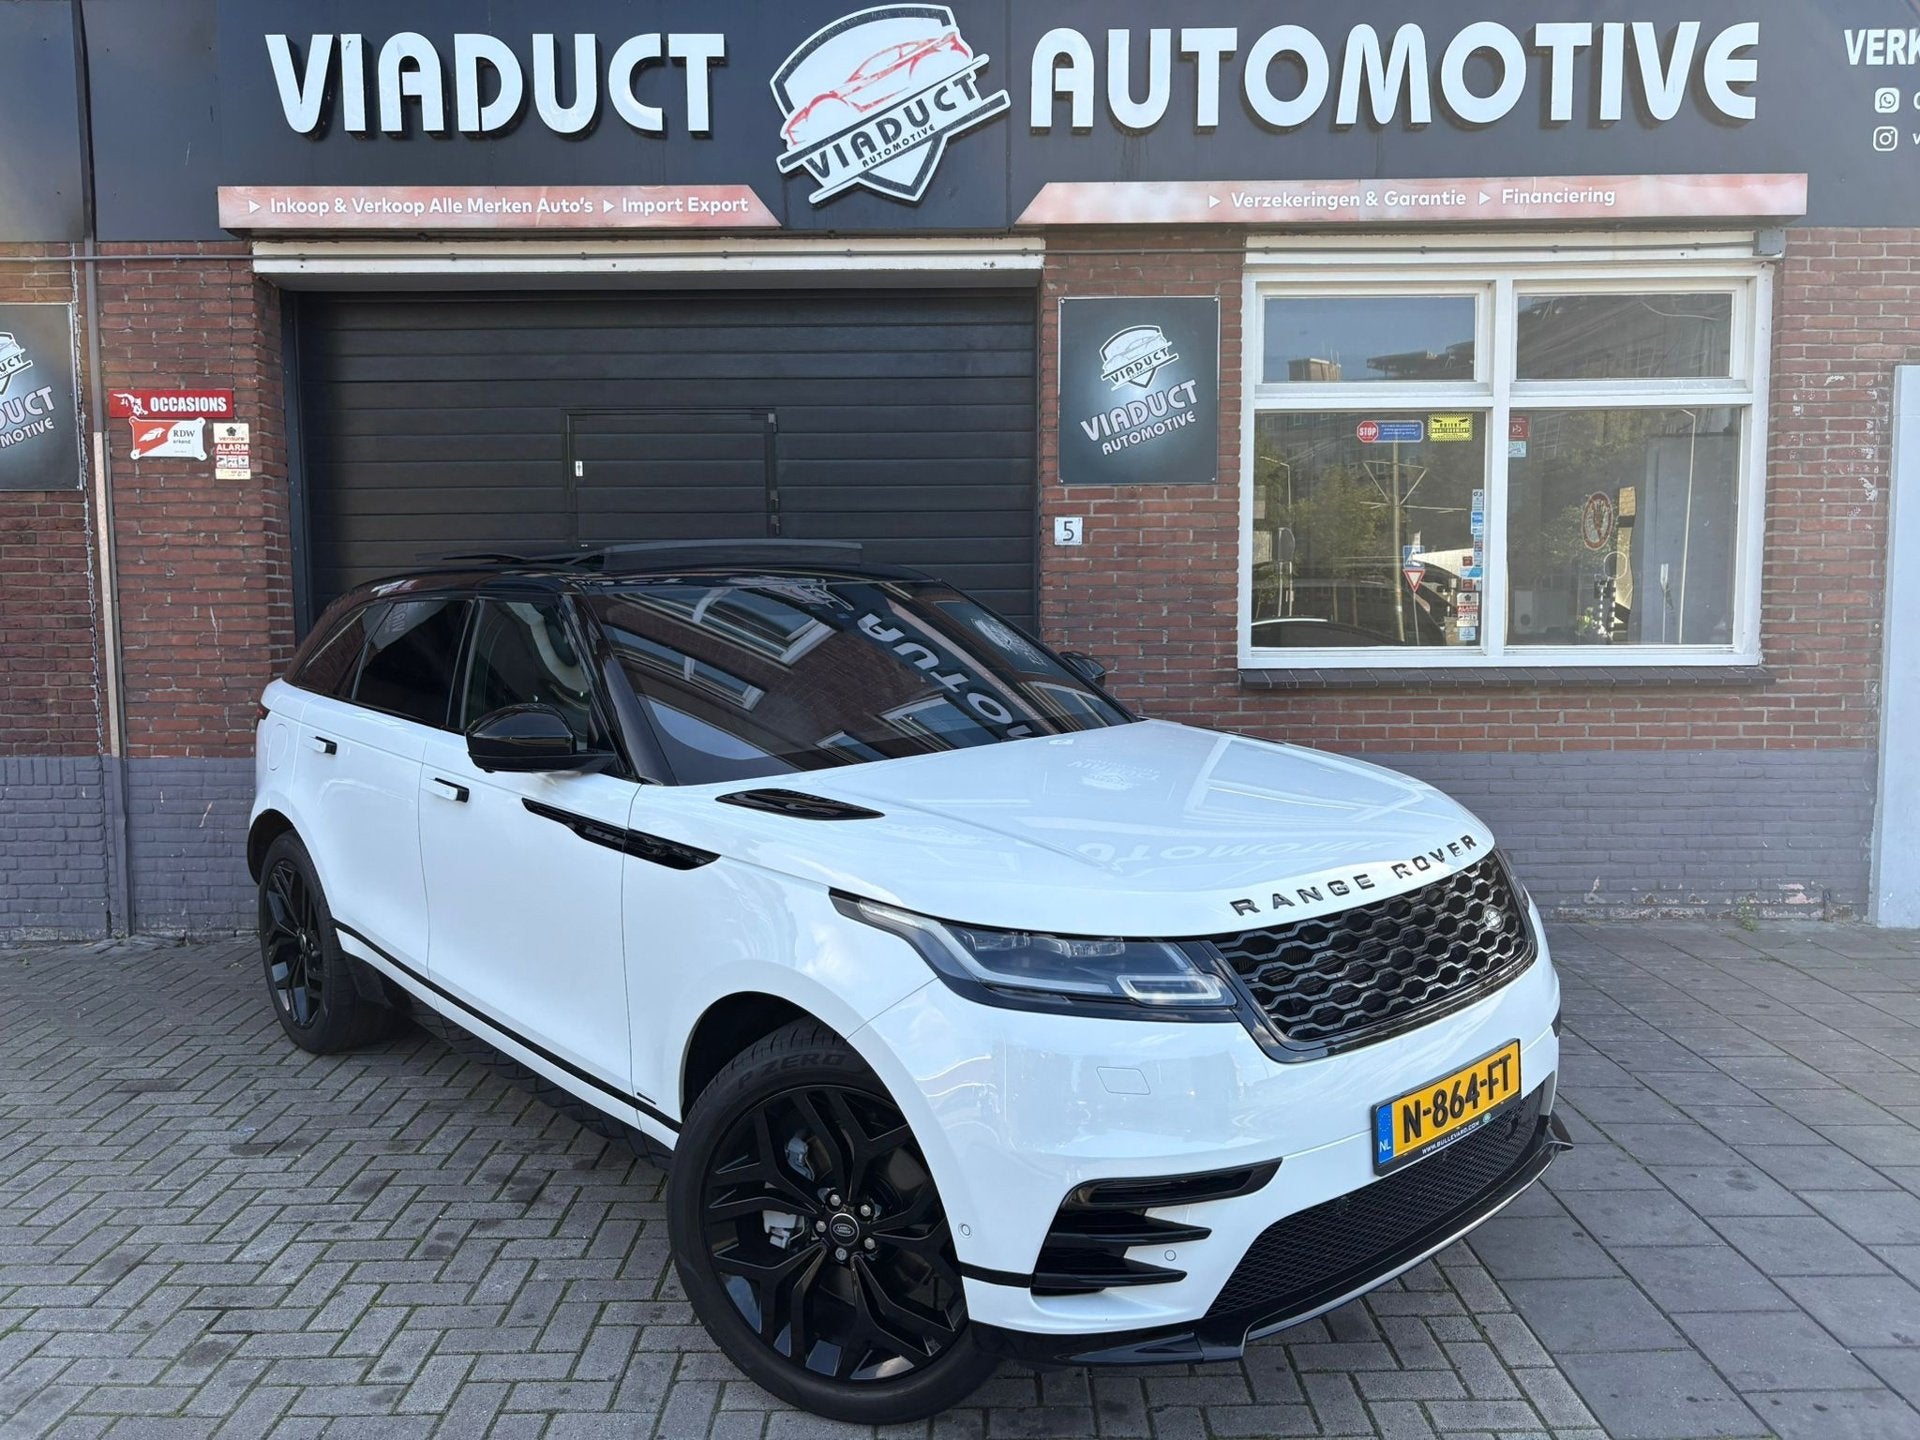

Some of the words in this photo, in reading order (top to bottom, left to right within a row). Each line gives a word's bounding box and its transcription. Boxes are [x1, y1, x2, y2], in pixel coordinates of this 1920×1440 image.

[265, 31, 725, 133] VIADUCT
[1030, 21, 1760, 130] AUTOMOTIVE
[805, 72, 976, 179] VIADUCT
[861, 123, 936, 168] AUTOMOTIVE
[270, 197, 330, 217] Inkoop
[334, 197, 348, 214] &
[351, 197, 426, 217] Verkoop
[429, 197, 463, 214] Alle
[467, 197, 533, 214] Merken
[622, 197, 684, 217] Import
[688, 196, 749, 216] Export
[1231, 190, 1361, 211] Verzekeringen
[1365, 190, 1379, 207] &
[1384, 190, 1467, 207] Garantie
[1501, 186, 1616, 207] Financiering
[1110, 348, 1169, 383] VIADUCT
[149, 396, 228, 413] OCCASIONS
[1081, 379, 1199, 442] VIADUCT
[173, 429, 196, 438] RDW
[216, 443, 249, 452] ALARM
[1101, 410, 1197, 456] AUTOMOTIVE
[1359, 427, 1377, 436] STOP
[1062, 521, 1075, 542] 5
[1229, 873, 1375, 917] RANGE
[1391, 833, 1478, 880] ROVER
[1402, 1053, 1513, 1144] N-864-FT
[1379, 1139, 1391, 1152] NL
